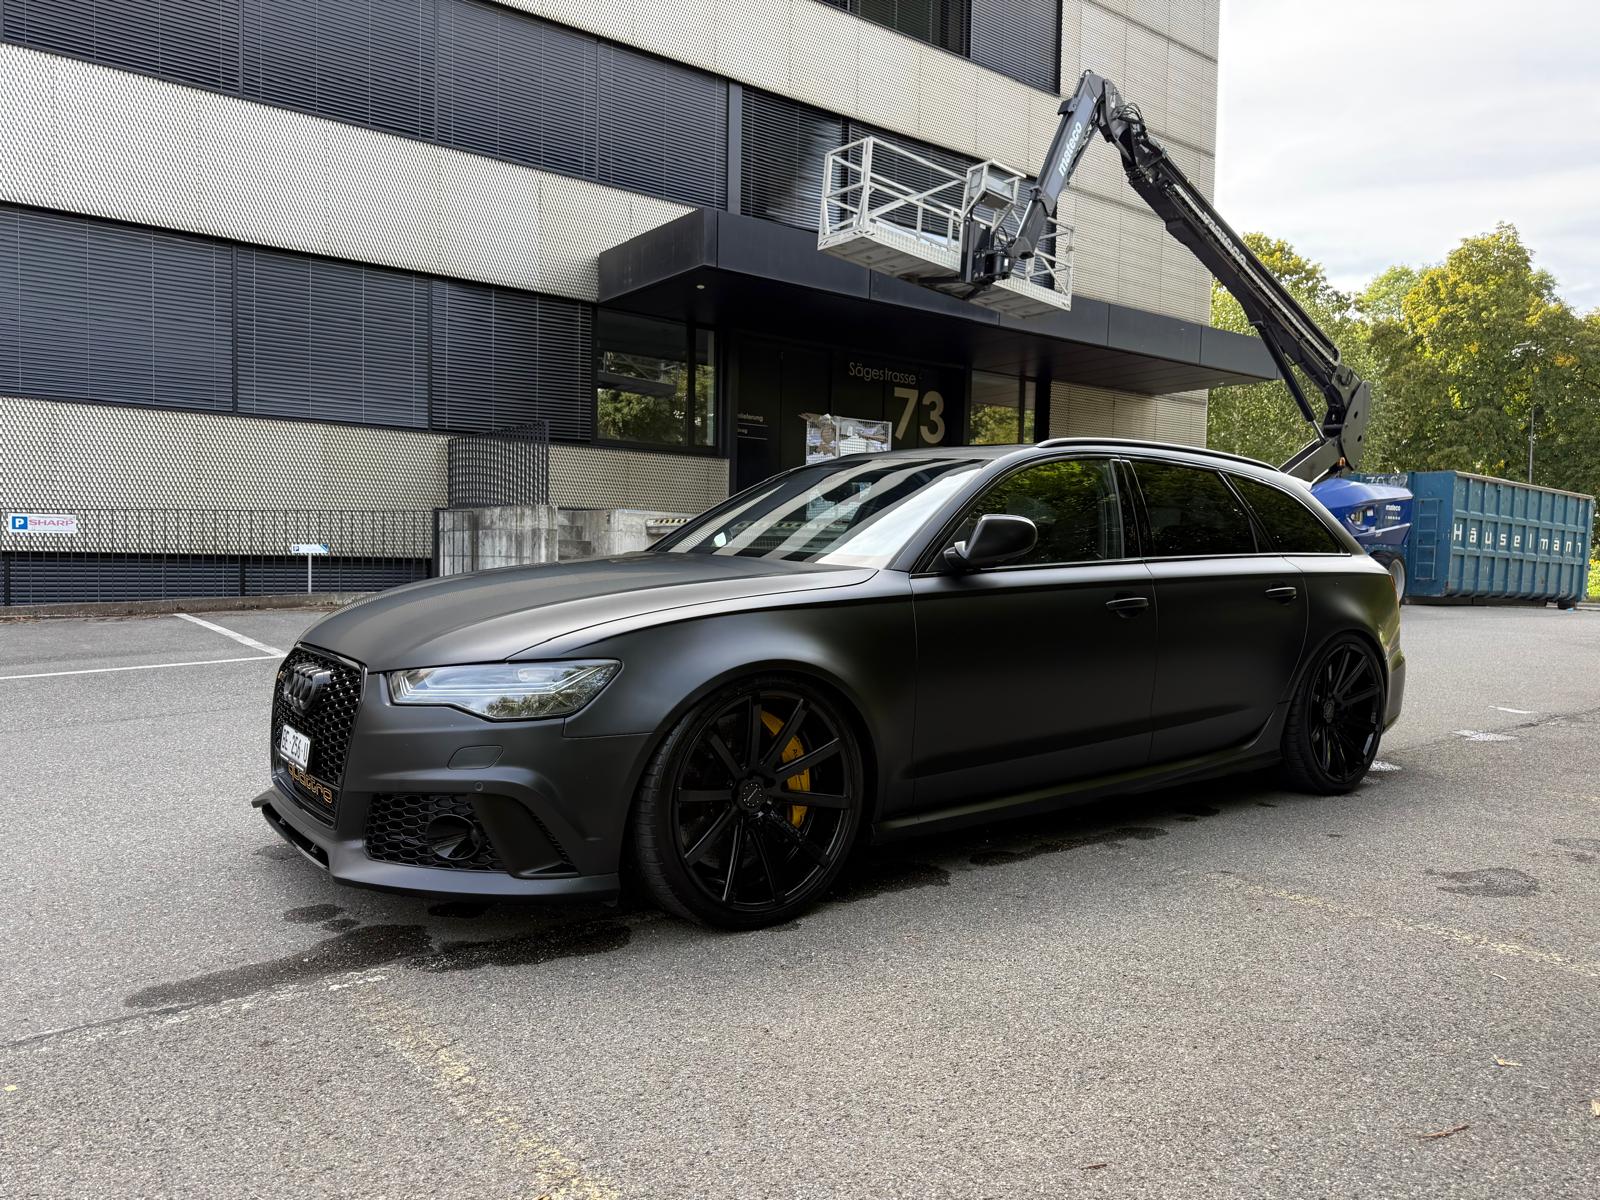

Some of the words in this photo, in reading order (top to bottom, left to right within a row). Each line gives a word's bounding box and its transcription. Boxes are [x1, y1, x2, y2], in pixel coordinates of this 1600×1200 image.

[1058, 121, 1082, 177] mateco
[849, 361, 916, 385] Sägestrasse
[894, 386, 946, 444] 73
[29, 519, 74, 527] SHARP
